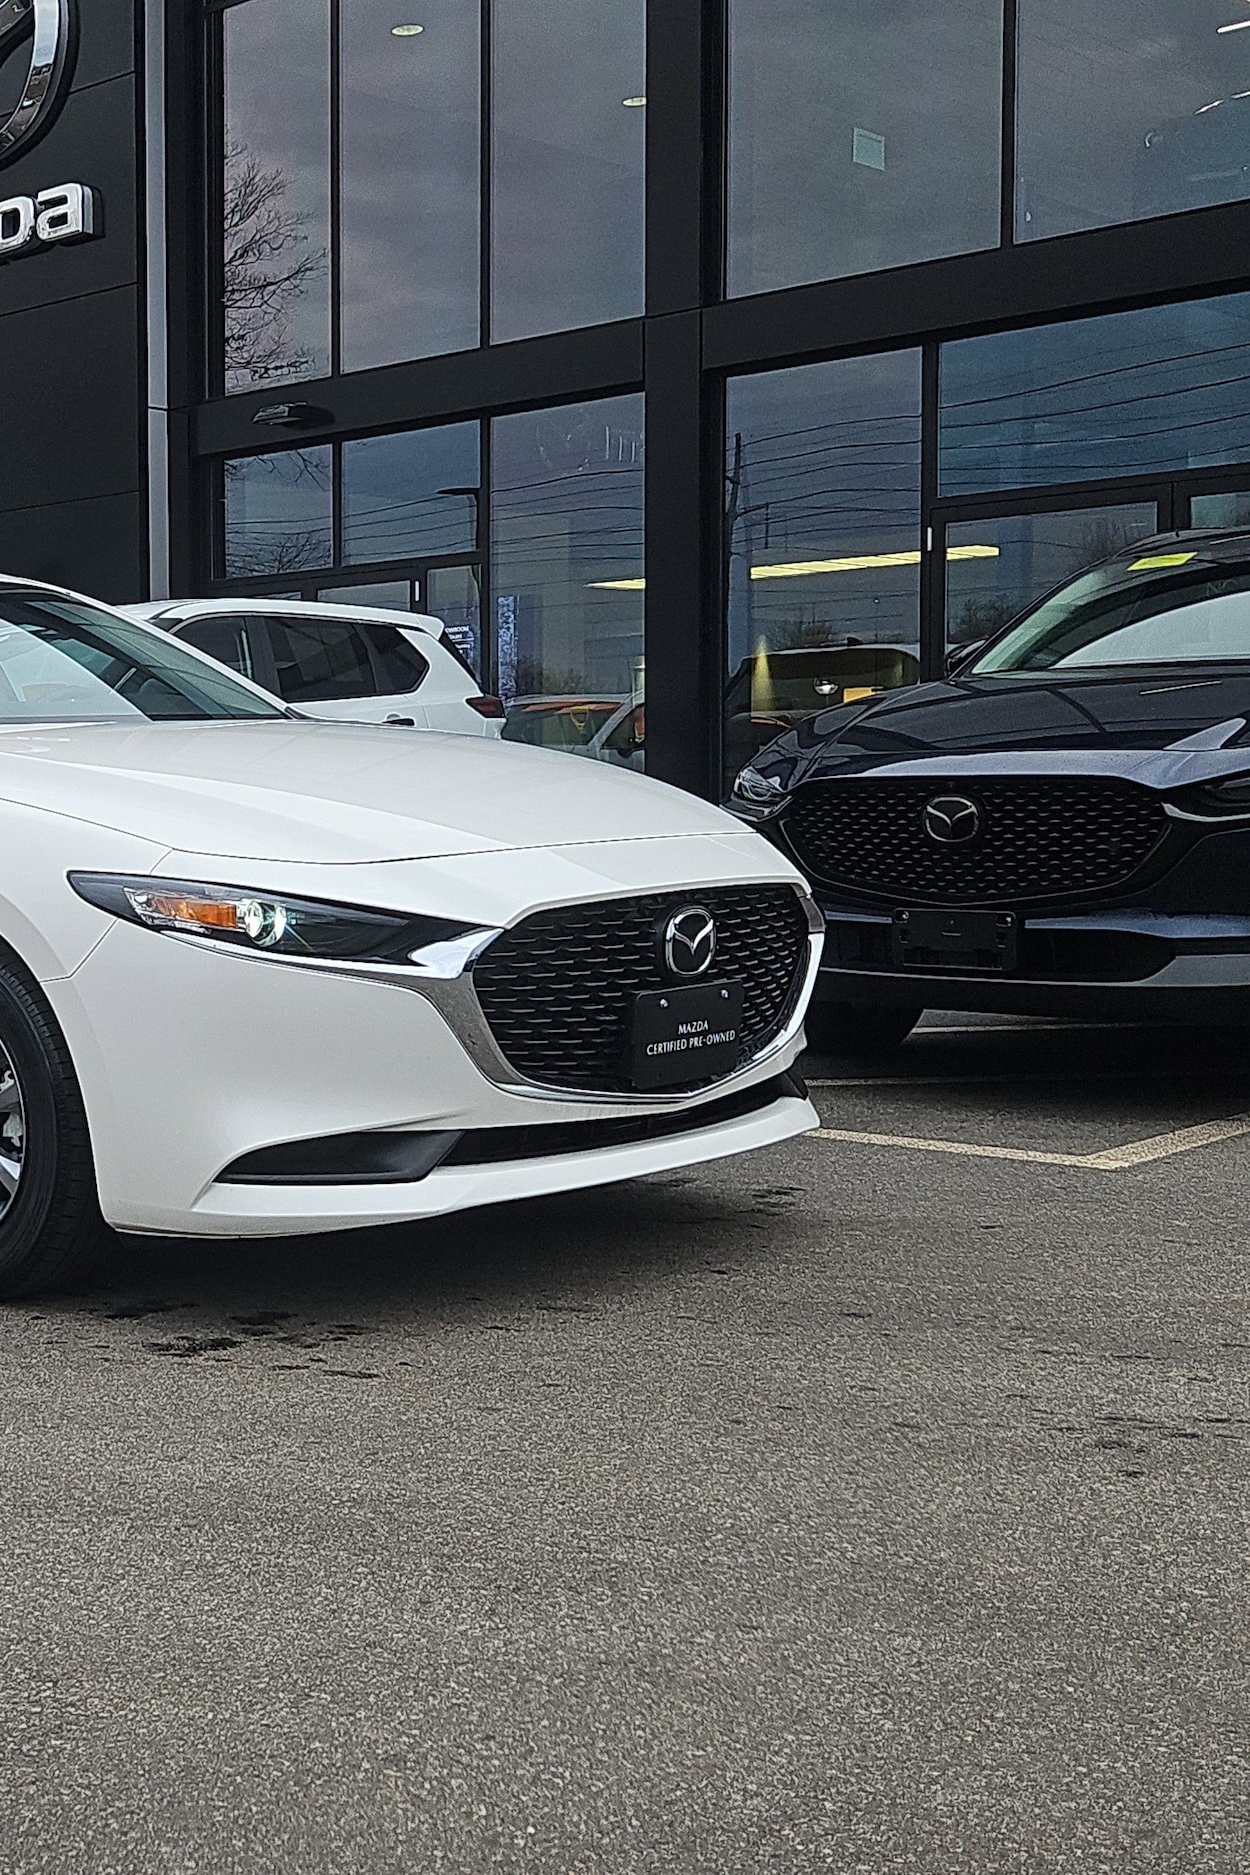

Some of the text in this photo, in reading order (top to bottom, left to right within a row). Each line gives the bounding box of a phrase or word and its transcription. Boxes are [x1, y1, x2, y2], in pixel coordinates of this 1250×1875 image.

[678, 1020, 709, 1035] MAZDA
[646, 1030, 736, 1056] CERTIFIED PRE-OWNED
